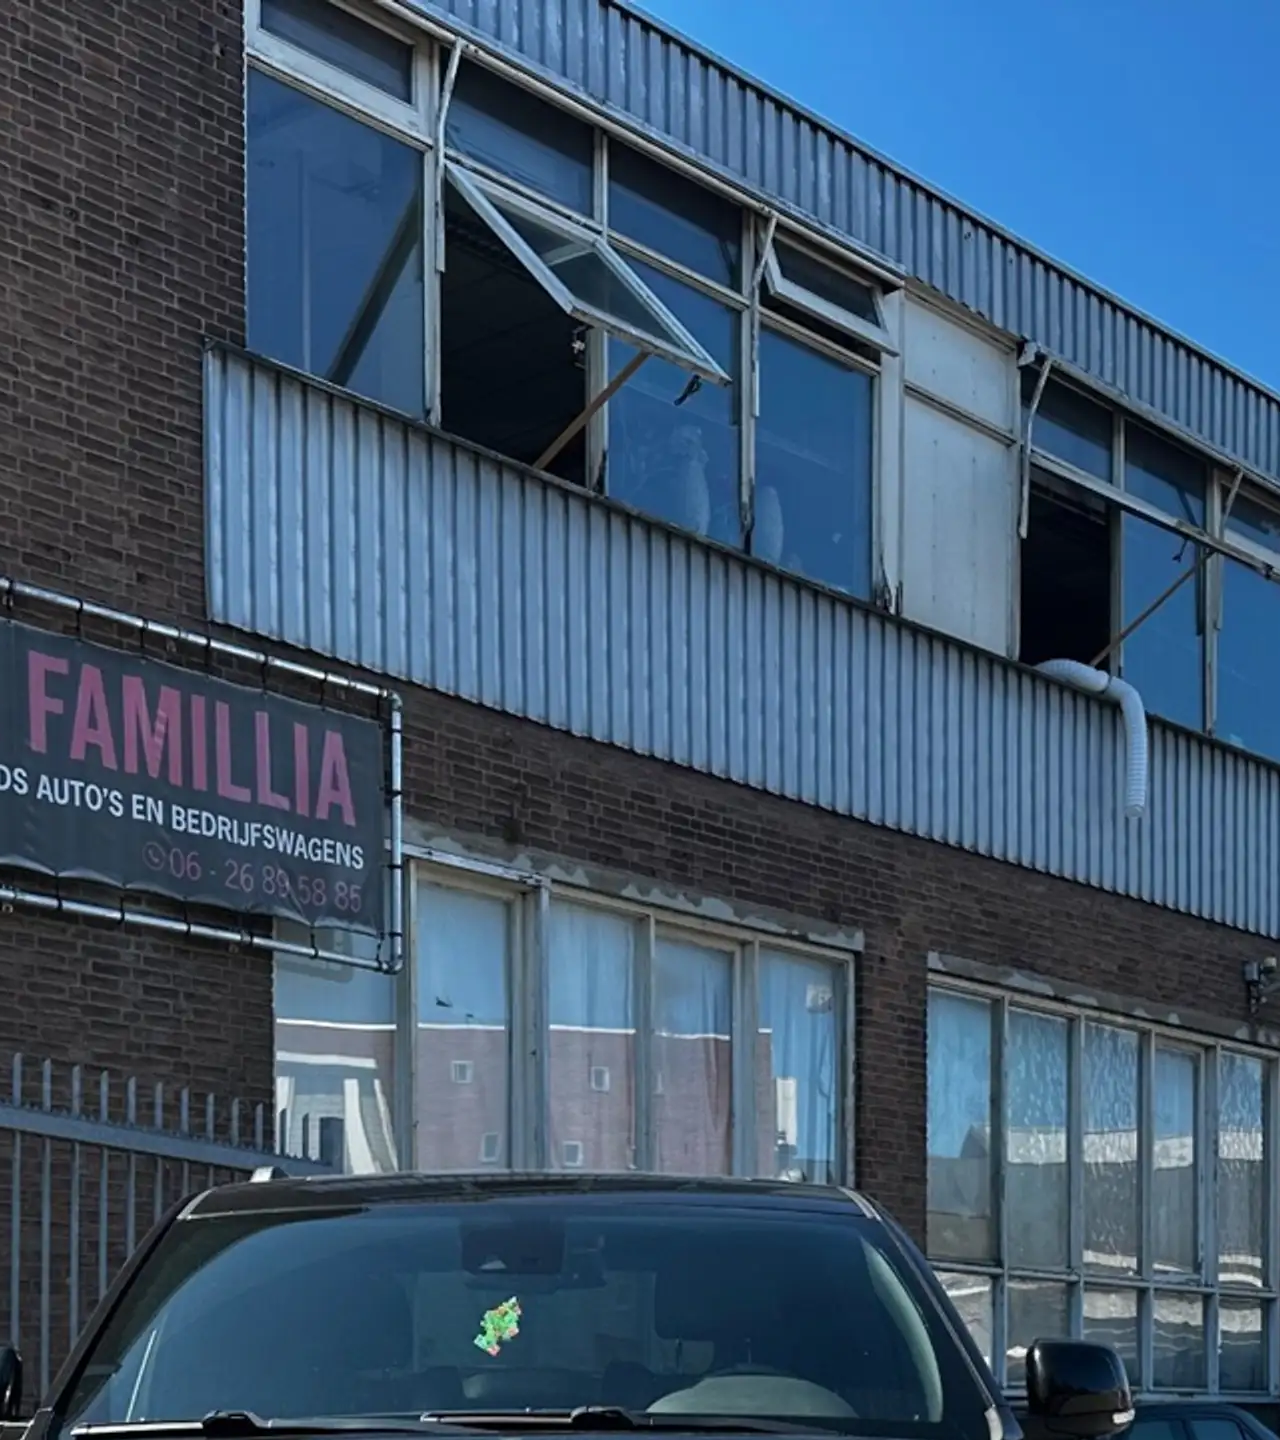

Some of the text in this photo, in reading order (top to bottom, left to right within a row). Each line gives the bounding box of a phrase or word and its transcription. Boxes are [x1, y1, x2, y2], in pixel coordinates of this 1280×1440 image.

[26, 649, 357, 827] FAMILLIA
[36, 774, 124, 818] AUTO'S
[131, 794, 164, 826] EN
[171, 809, 365, 870] BEDRIJFSWAGENS
[169, 847, 202, 881] 06
[224, 858, 255, 893] 26
[333, 880, 362, 913] 85
